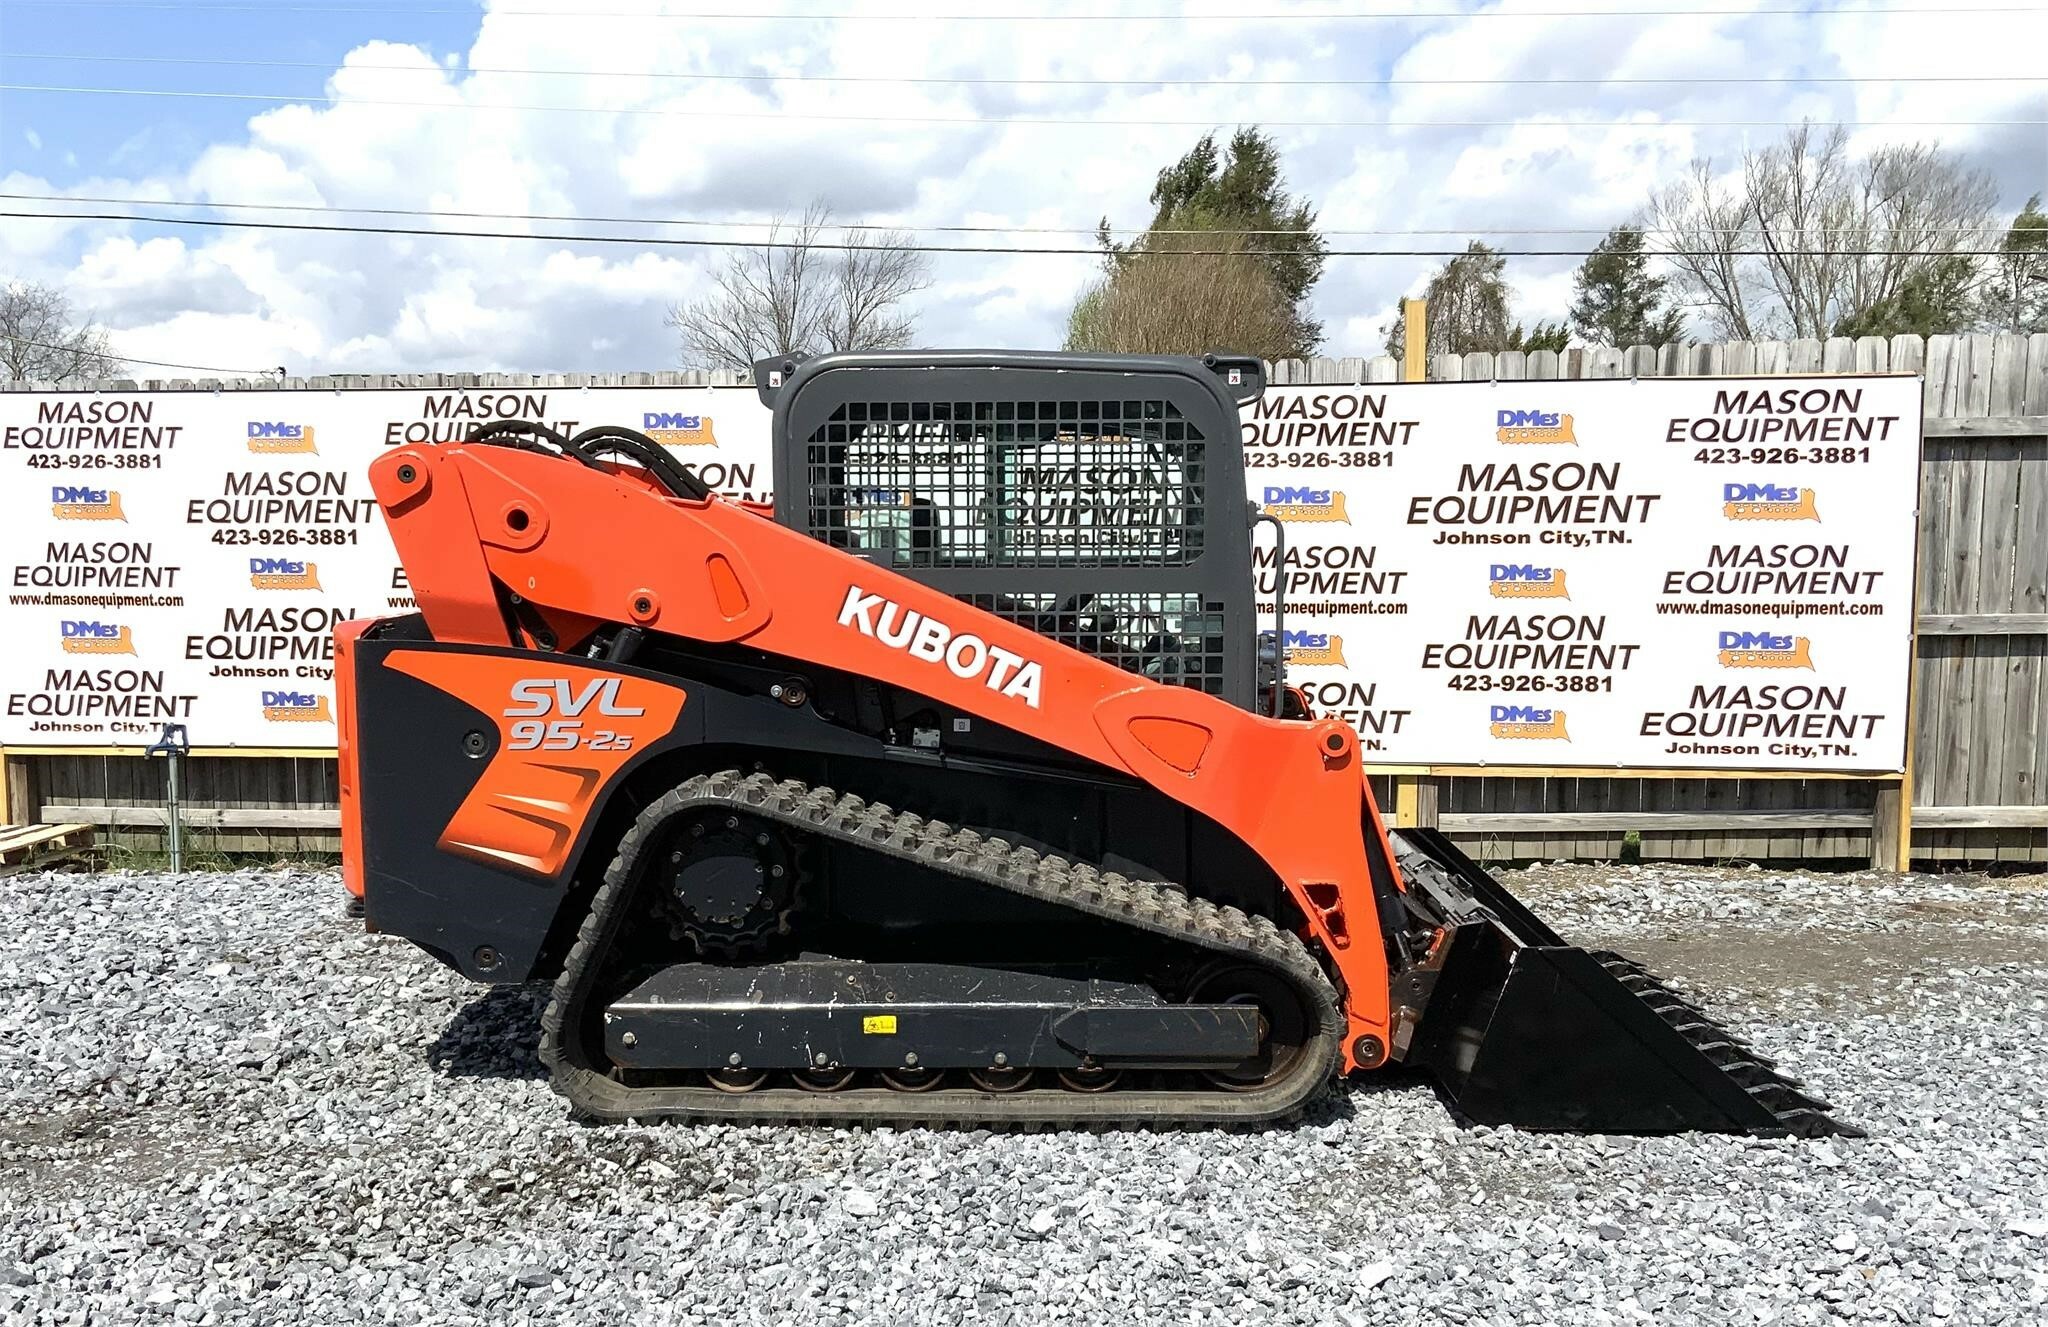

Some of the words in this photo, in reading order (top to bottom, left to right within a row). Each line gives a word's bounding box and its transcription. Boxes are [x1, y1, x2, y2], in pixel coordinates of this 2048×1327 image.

[39, 401, 152, 423] MASON
[424, 395, 546, 418] MASON
[1254, 395, 1387, 420] MASON
[1714, 389, 1862, 414] MASON
[4, 427, 182, 449] EQUIPMENT
[384, 421, 579, 445] EQUIPNT
[1242, 422, 1420, 447] QUIPMENT
[1666, 417, 1899, 442] EQUIPMENT
[27, 454, 160, 469] 423-926-3881
[1694, 447, 1869, 464] 423-926-3881
[224, 472, 346, 496] MASON
[685, 463, 755, 488] SON
[1458, 463, 1620, 491] MASON
[186, 499, 377, 524] EQUIPMENT
[1407, 495, 1661, 524] EQUIPMENT
[212, 529, 357, 545] 423-926-3881
[1433, 531, 1530, 544] Johnson
[1540, 530, 1632, 547] City,TN.
[47, 543, 151, 563] MASON
[1253, 546, 1376, 569] MASON
[1708, 545, 1849, 568] MASON
[14, 566, 180, 587] EQUIPMENT
[1253, 572, 1408, 594] UIPMENT
[1663, 571, 1883, 594] EQUIPMENT
[10, 592, 183, 609] www.dmasonequipment.com
[1656, 600, 1883, 618] www.dmasonequipment.com
[223, 608, 355, 633] MASON
[1466, 615, 1605, 641] MASON
[185, 635, 334, 660] EQUIPME
[837, 584, 1043, 710] KUBOTA
[1422, 644, 1640, 669] EQUIPMENT
[45, 669, 163, 692] MASON
[209, 665, 288, 677] Johnson
[1300, 682, 1376, 706] SON
[1448, 675, 1611, 692] 423-926-3881
[8, 694, 198, 717] EQUIPMENT
[503, 678, 645, 717] SVL
[1690, 686, 1846, 710] MASON
[30, 721, 103, 731] Johnson
[1640, 713, 1885, 738] EQUIPMENT
[1665, 743, 1759, 754] Johnson
[1769, 744, 1857, 758] City,TN.
